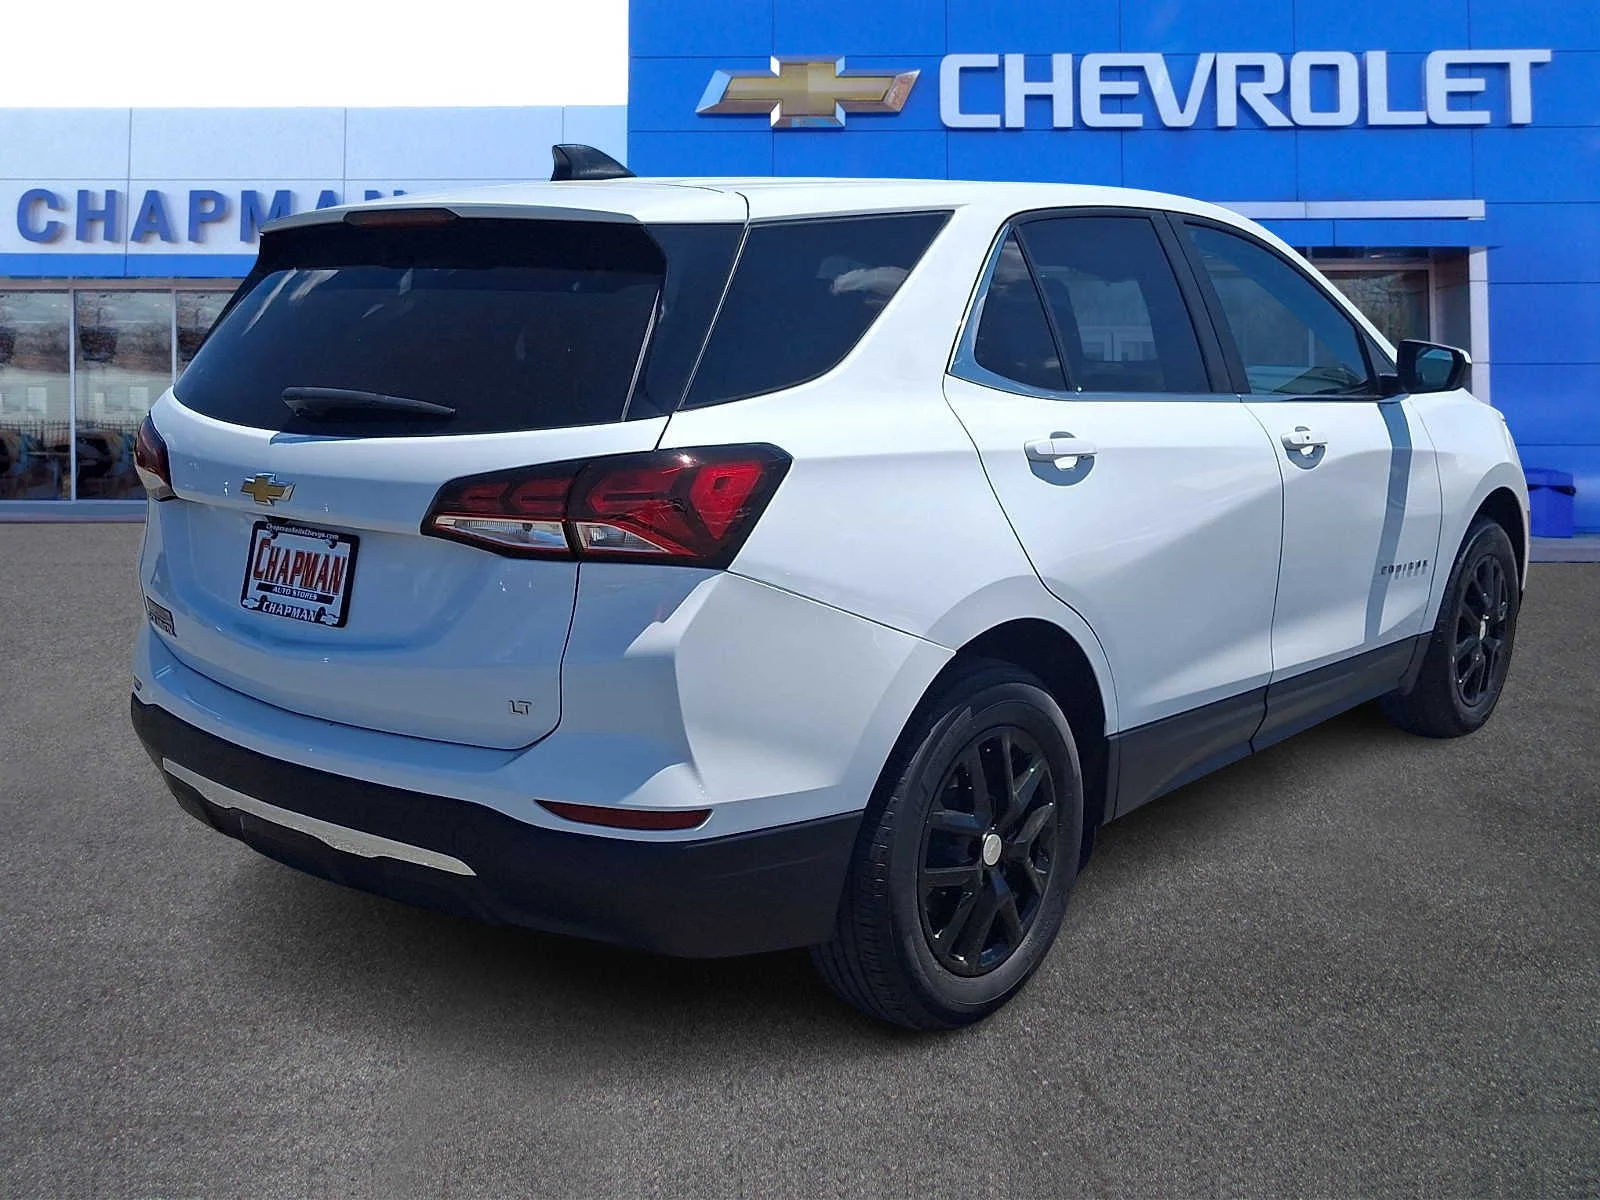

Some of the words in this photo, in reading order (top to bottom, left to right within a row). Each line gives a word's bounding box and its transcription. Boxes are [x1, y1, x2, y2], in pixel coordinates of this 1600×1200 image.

[939, 49, 1552, 129] CHEVROLET
[17, 188, 408, 243] CHAPM
[253, 538, 347, 595] CHAPMAN
[262, 601, 317, 621] CHAPMAN
[272, 586, 291, 595] AUTO
[292, 589, 318, 600] STORES
[508, 699, 533, 716] LT
